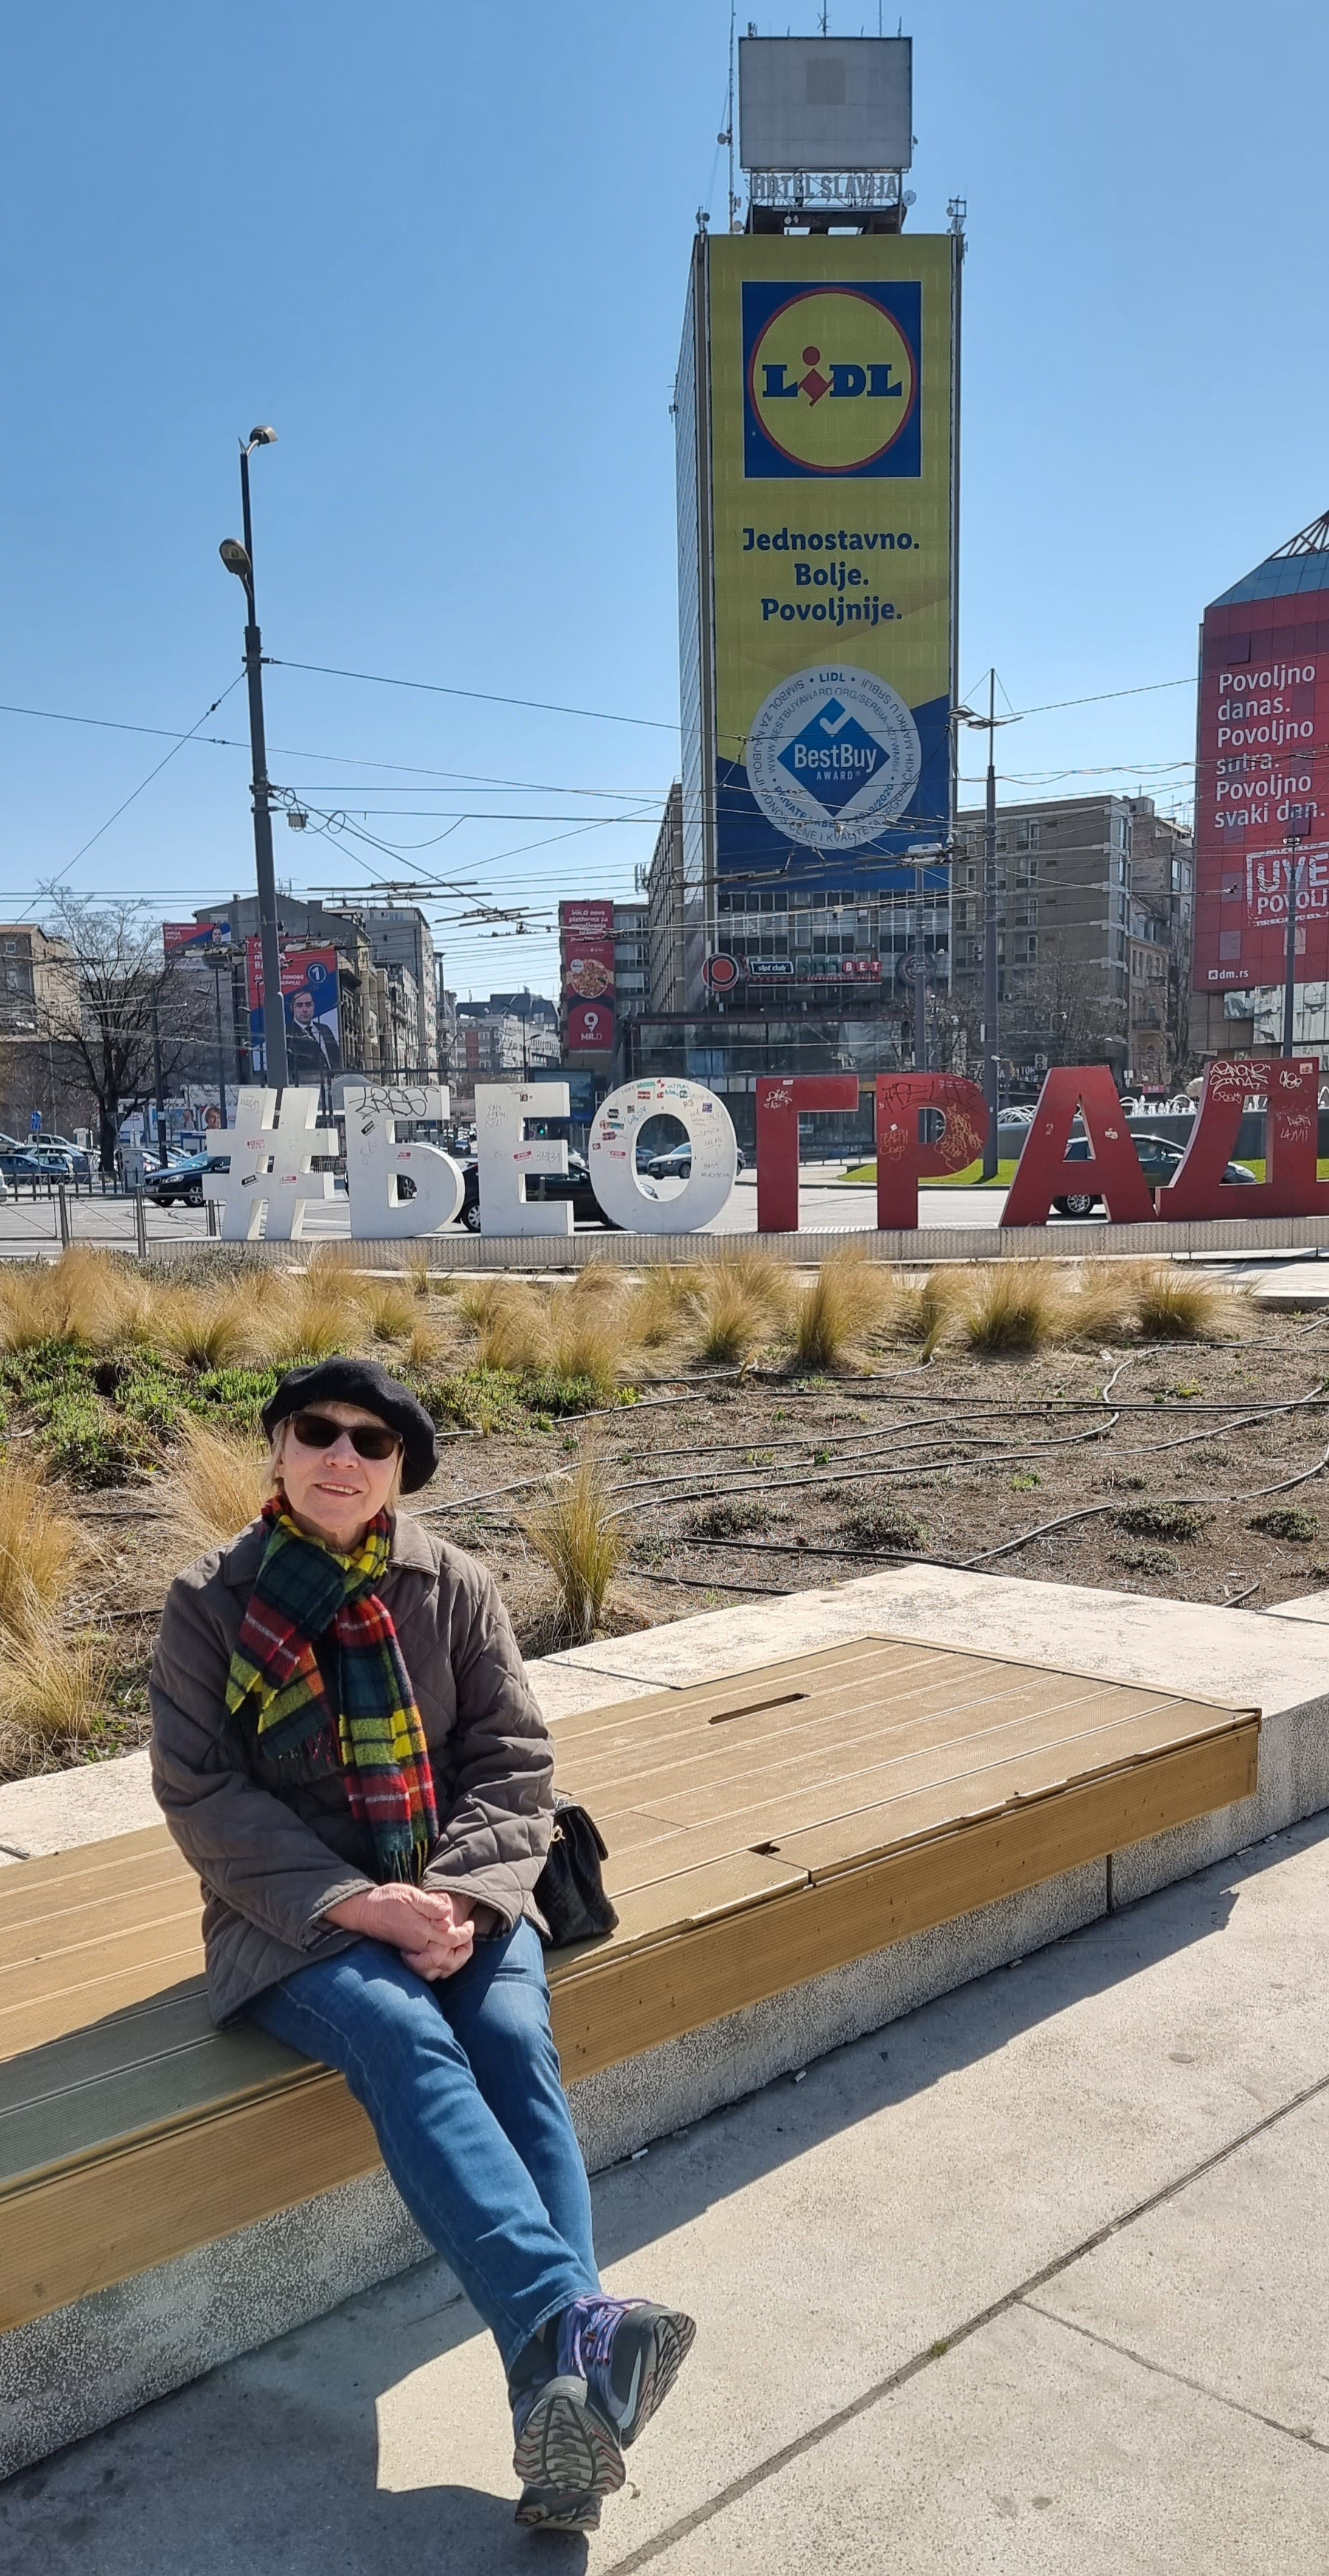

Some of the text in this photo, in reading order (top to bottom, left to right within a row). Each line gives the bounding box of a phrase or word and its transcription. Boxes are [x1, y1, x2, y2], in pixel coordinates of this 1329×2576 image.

[754, 175, 897, 198] HOTEL SLAVIJA
[743, 528, 920, 551] Jednostavno.
[794, 562, 869, 590] Bolje.
[761, 598, 902, 626] Povoljnije.
[820, 672, 845, 682] LIDL
[1219, 664, 1316, 695] Povoljno
[769, 680, 805, 709] SIMBOL
[861, 678, 893, 705] SRBIJI
[760, 712, 773, 727] ZA
[889, 703, 900, 714] U
[1218, 697, 1291, 721] danas.
[896, 713, 914, 750] MARKI
[1218, 719, 1314, 748] Povoljno
[753, 730, 766, 786] NAJBOLJI
[794, 743, 877, 773] BestBuy
[1216, 752, 1280, 776] sutra.
[1216, 774, 1312, 802] Povoljno
[773, 785, 808, 819] PRIVATE
[854, 784, 894, 823] 209/2020
[1215, 799, 1326, 828] svaki dan.
[312, 966, 320, 981] 1
[1219, 969, 1249, 979] dm.rs
[584, 1012, 599, 1033] 9
